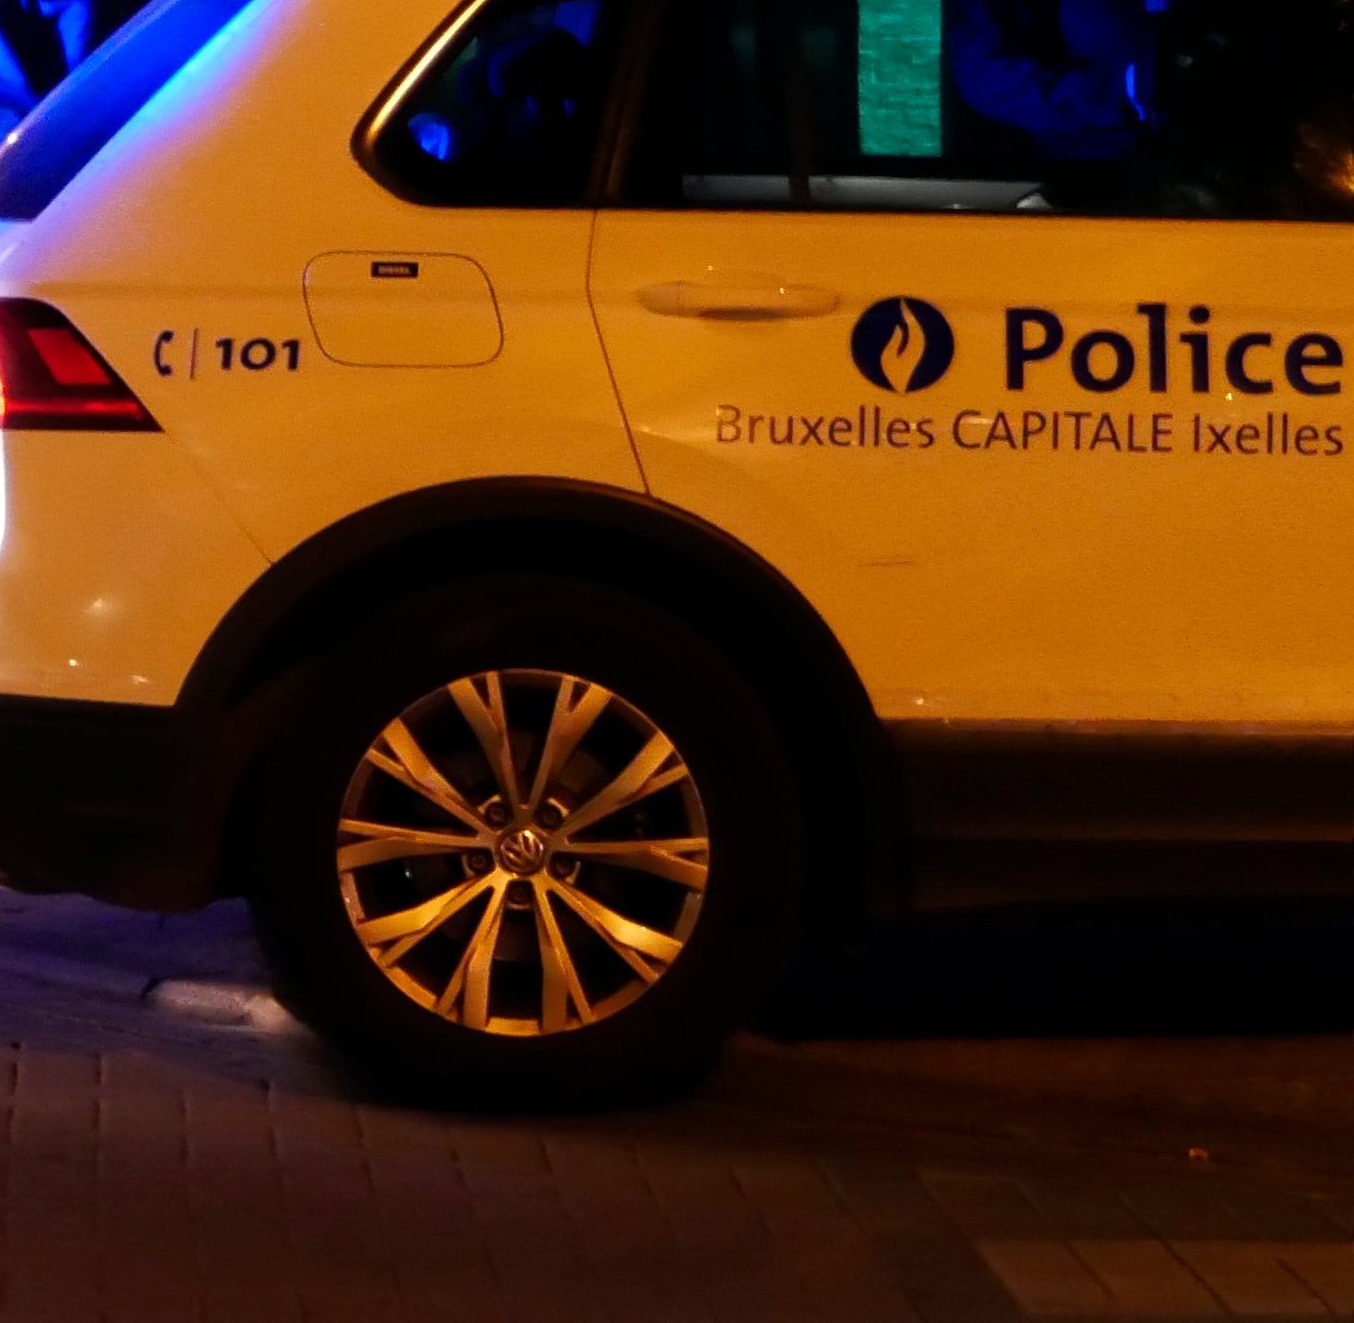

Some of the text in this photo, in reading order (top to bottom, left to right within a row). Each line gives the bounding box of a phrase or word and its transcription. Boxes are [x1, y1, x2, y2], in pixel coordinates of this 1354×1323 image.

[215, 337, 301, 371] 101
[1006, 302, 1345, 396] Police
[716, 404, 1345, 457] Bruxelles CAPITALE Ixelles
